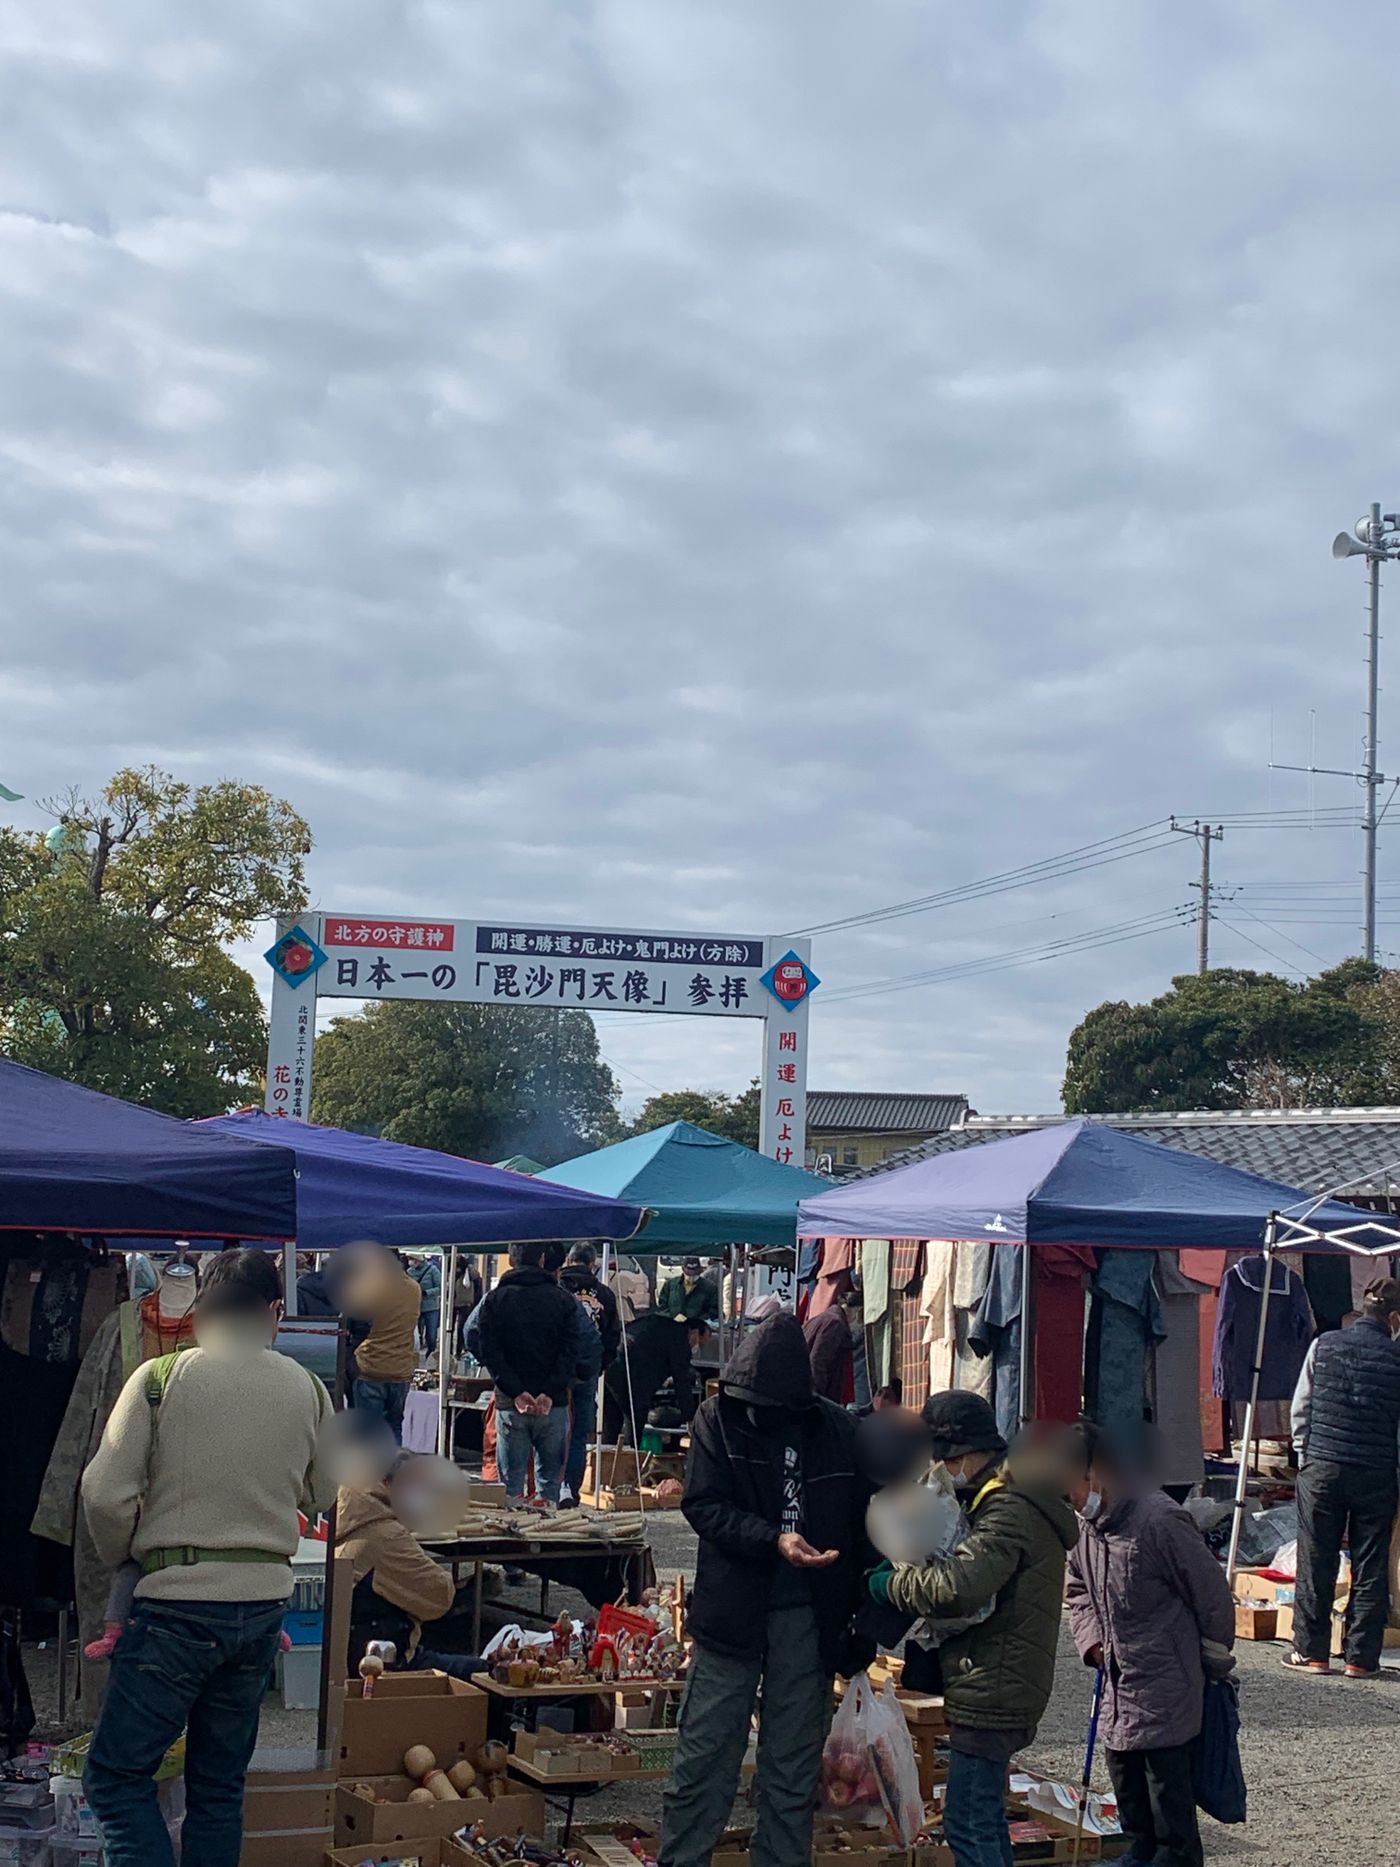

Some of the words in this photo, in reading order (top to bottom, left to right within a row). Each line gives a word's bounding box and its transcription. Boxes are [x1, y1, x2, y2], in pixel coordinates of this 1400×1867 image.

[334, 925, 445, 947] 北方の守護神
